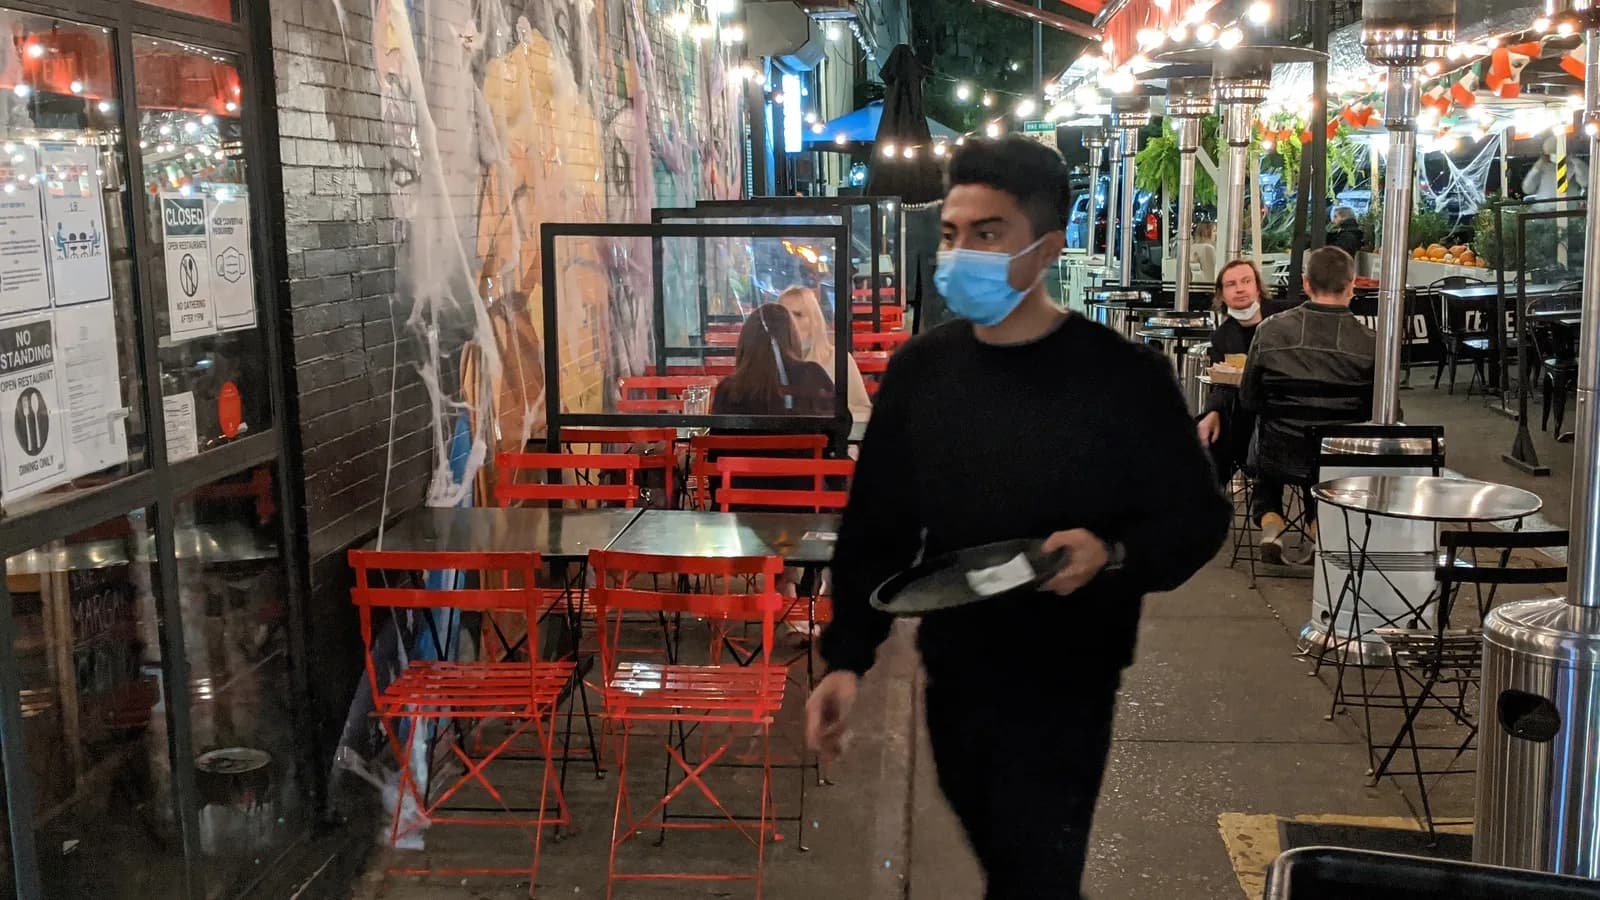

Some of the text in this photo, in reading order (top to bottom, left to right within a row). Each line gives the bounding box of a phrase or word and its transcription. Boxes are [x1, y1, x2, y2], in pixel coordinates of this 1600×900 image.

[165, 207, 204, 226] CLOSED
[177, 302, 183, 311] NO
[15, 330, 31, 347] NO
[0, 344, 51, 370] STANDING
[1, 379, 17, 393] OPEN
[19, 455, 54, 476] DINING ONLY
